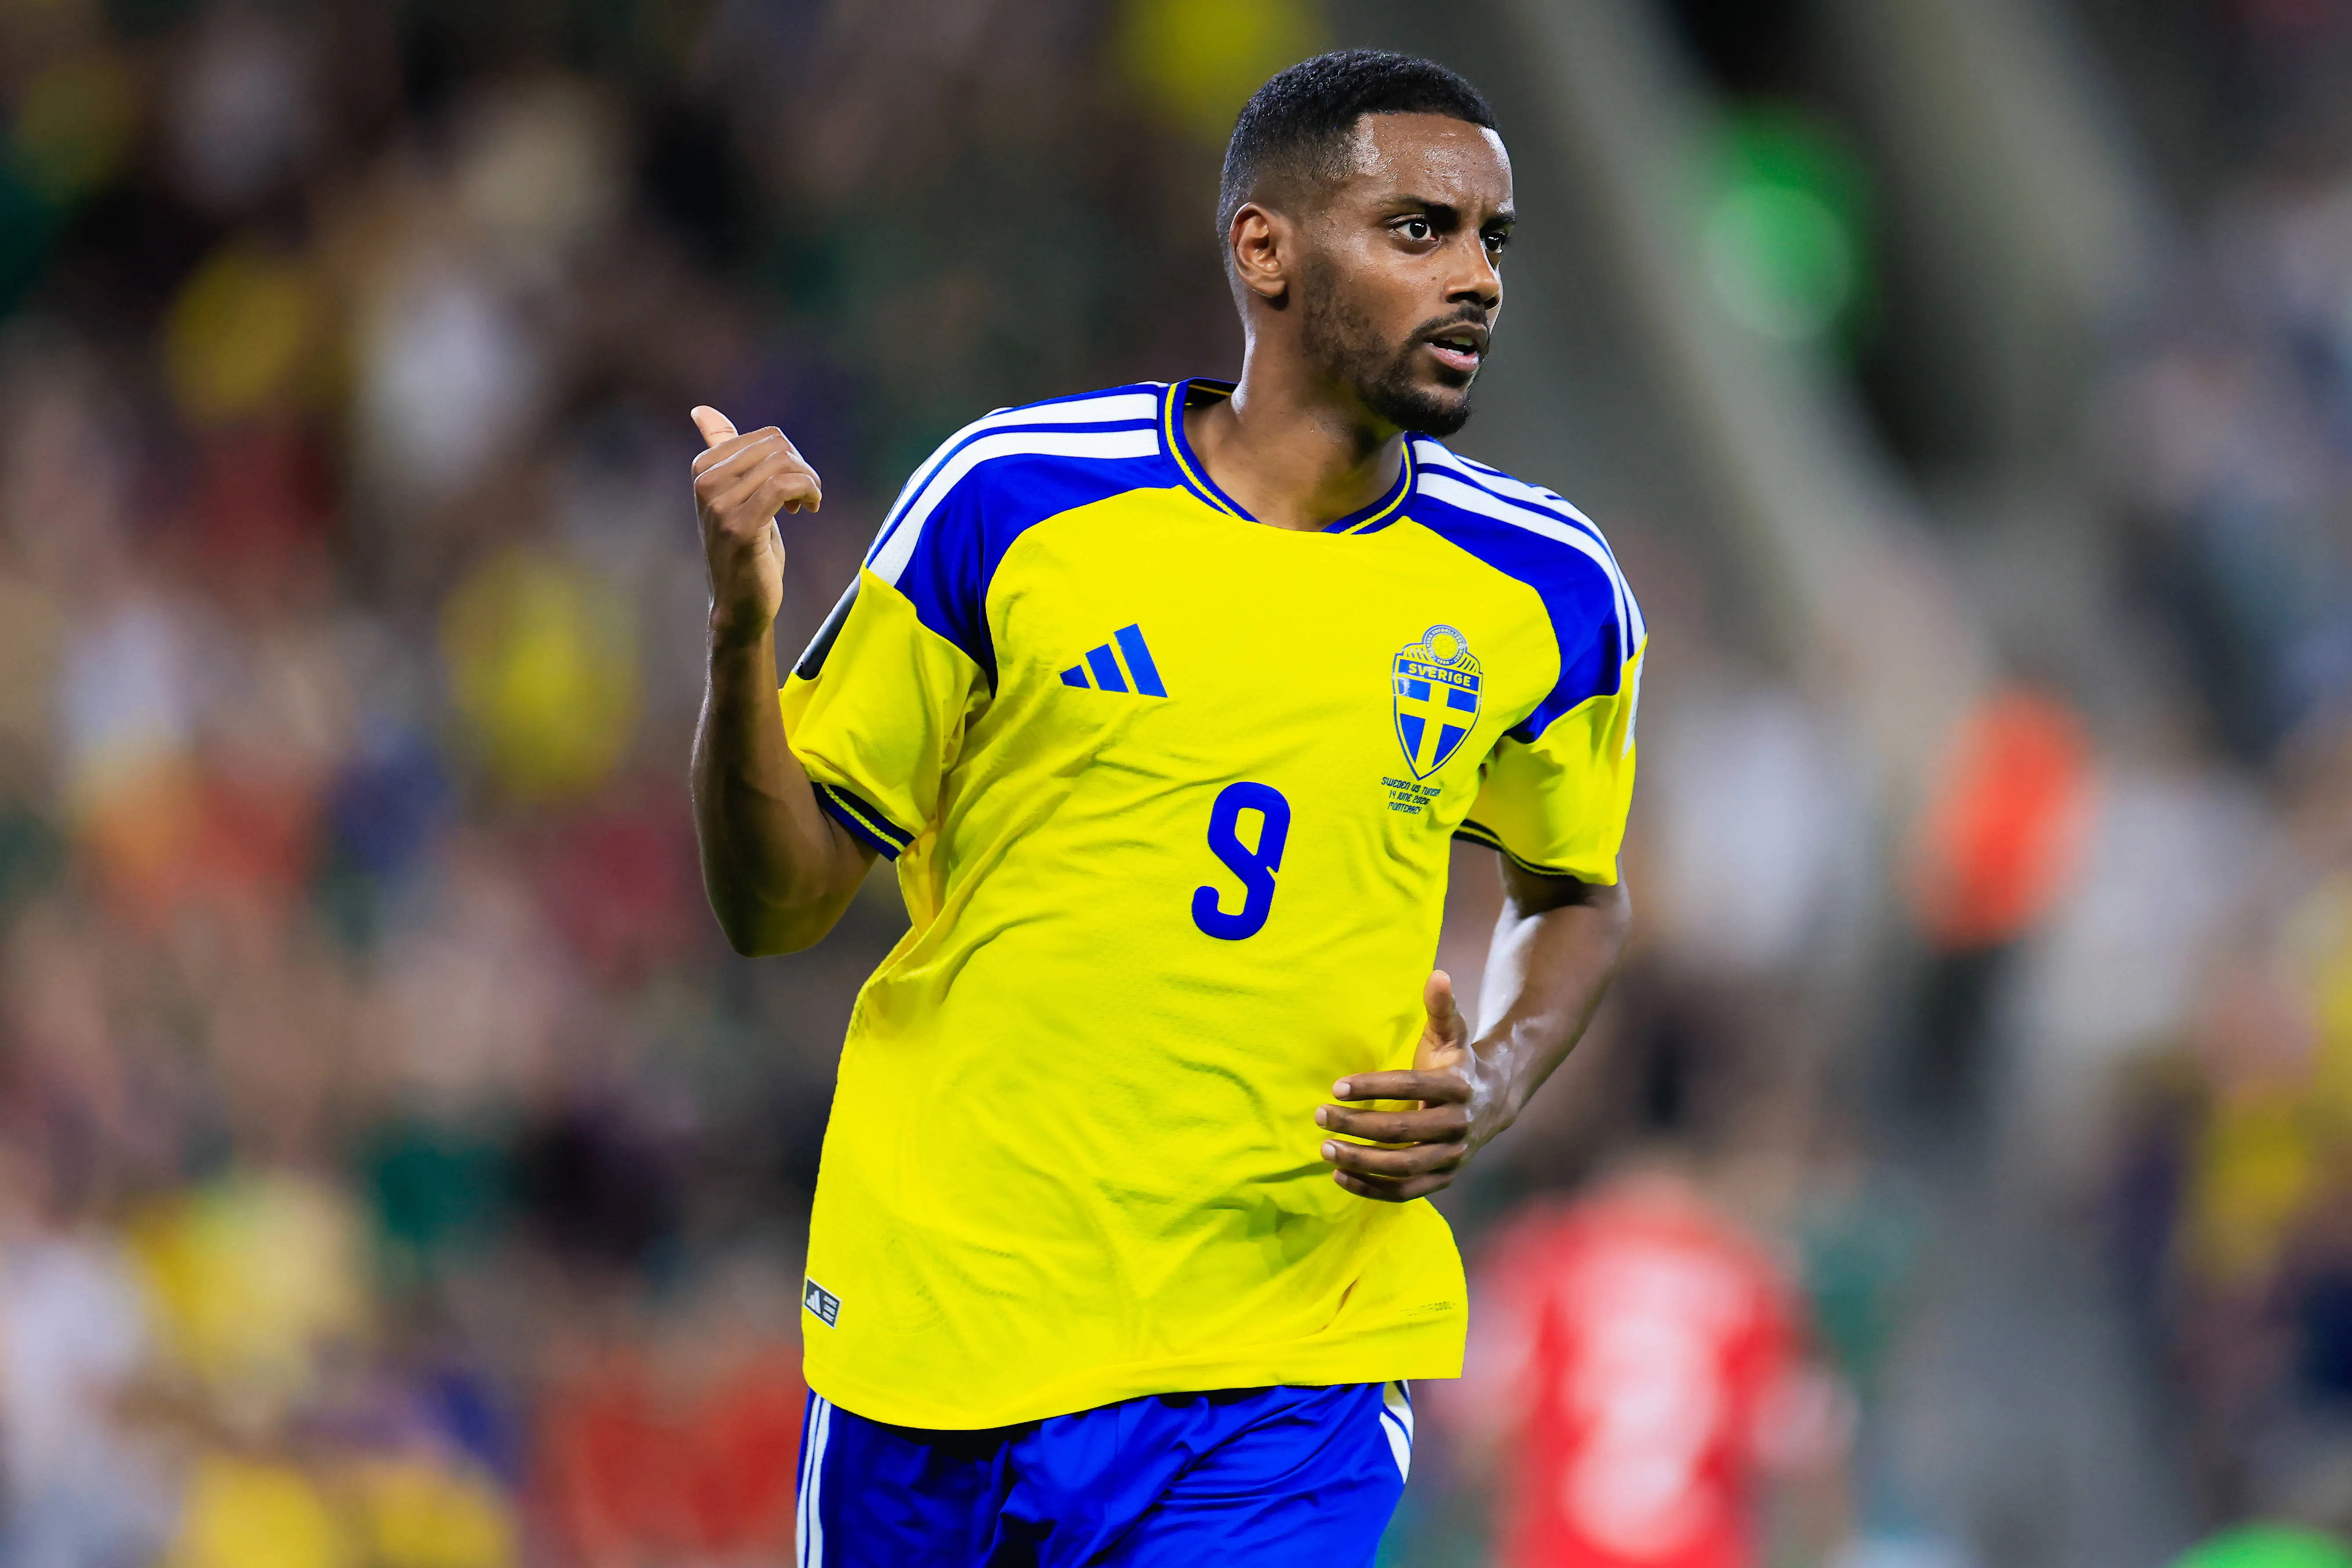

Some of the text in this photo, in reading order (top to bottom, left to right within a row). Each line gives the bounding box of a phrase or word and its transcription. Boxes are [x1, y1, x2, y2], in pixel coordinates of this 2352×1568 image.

[1408, 663, 1471, 687] SVERIGE
[1381, 776, 1411, 790] SWEDEN
[1389, 789, 1431, 805] 14 JUNE 2026
[1387, 801, 1423, 814] MONTERREY
[1191, 781, 1291, 941] 9
